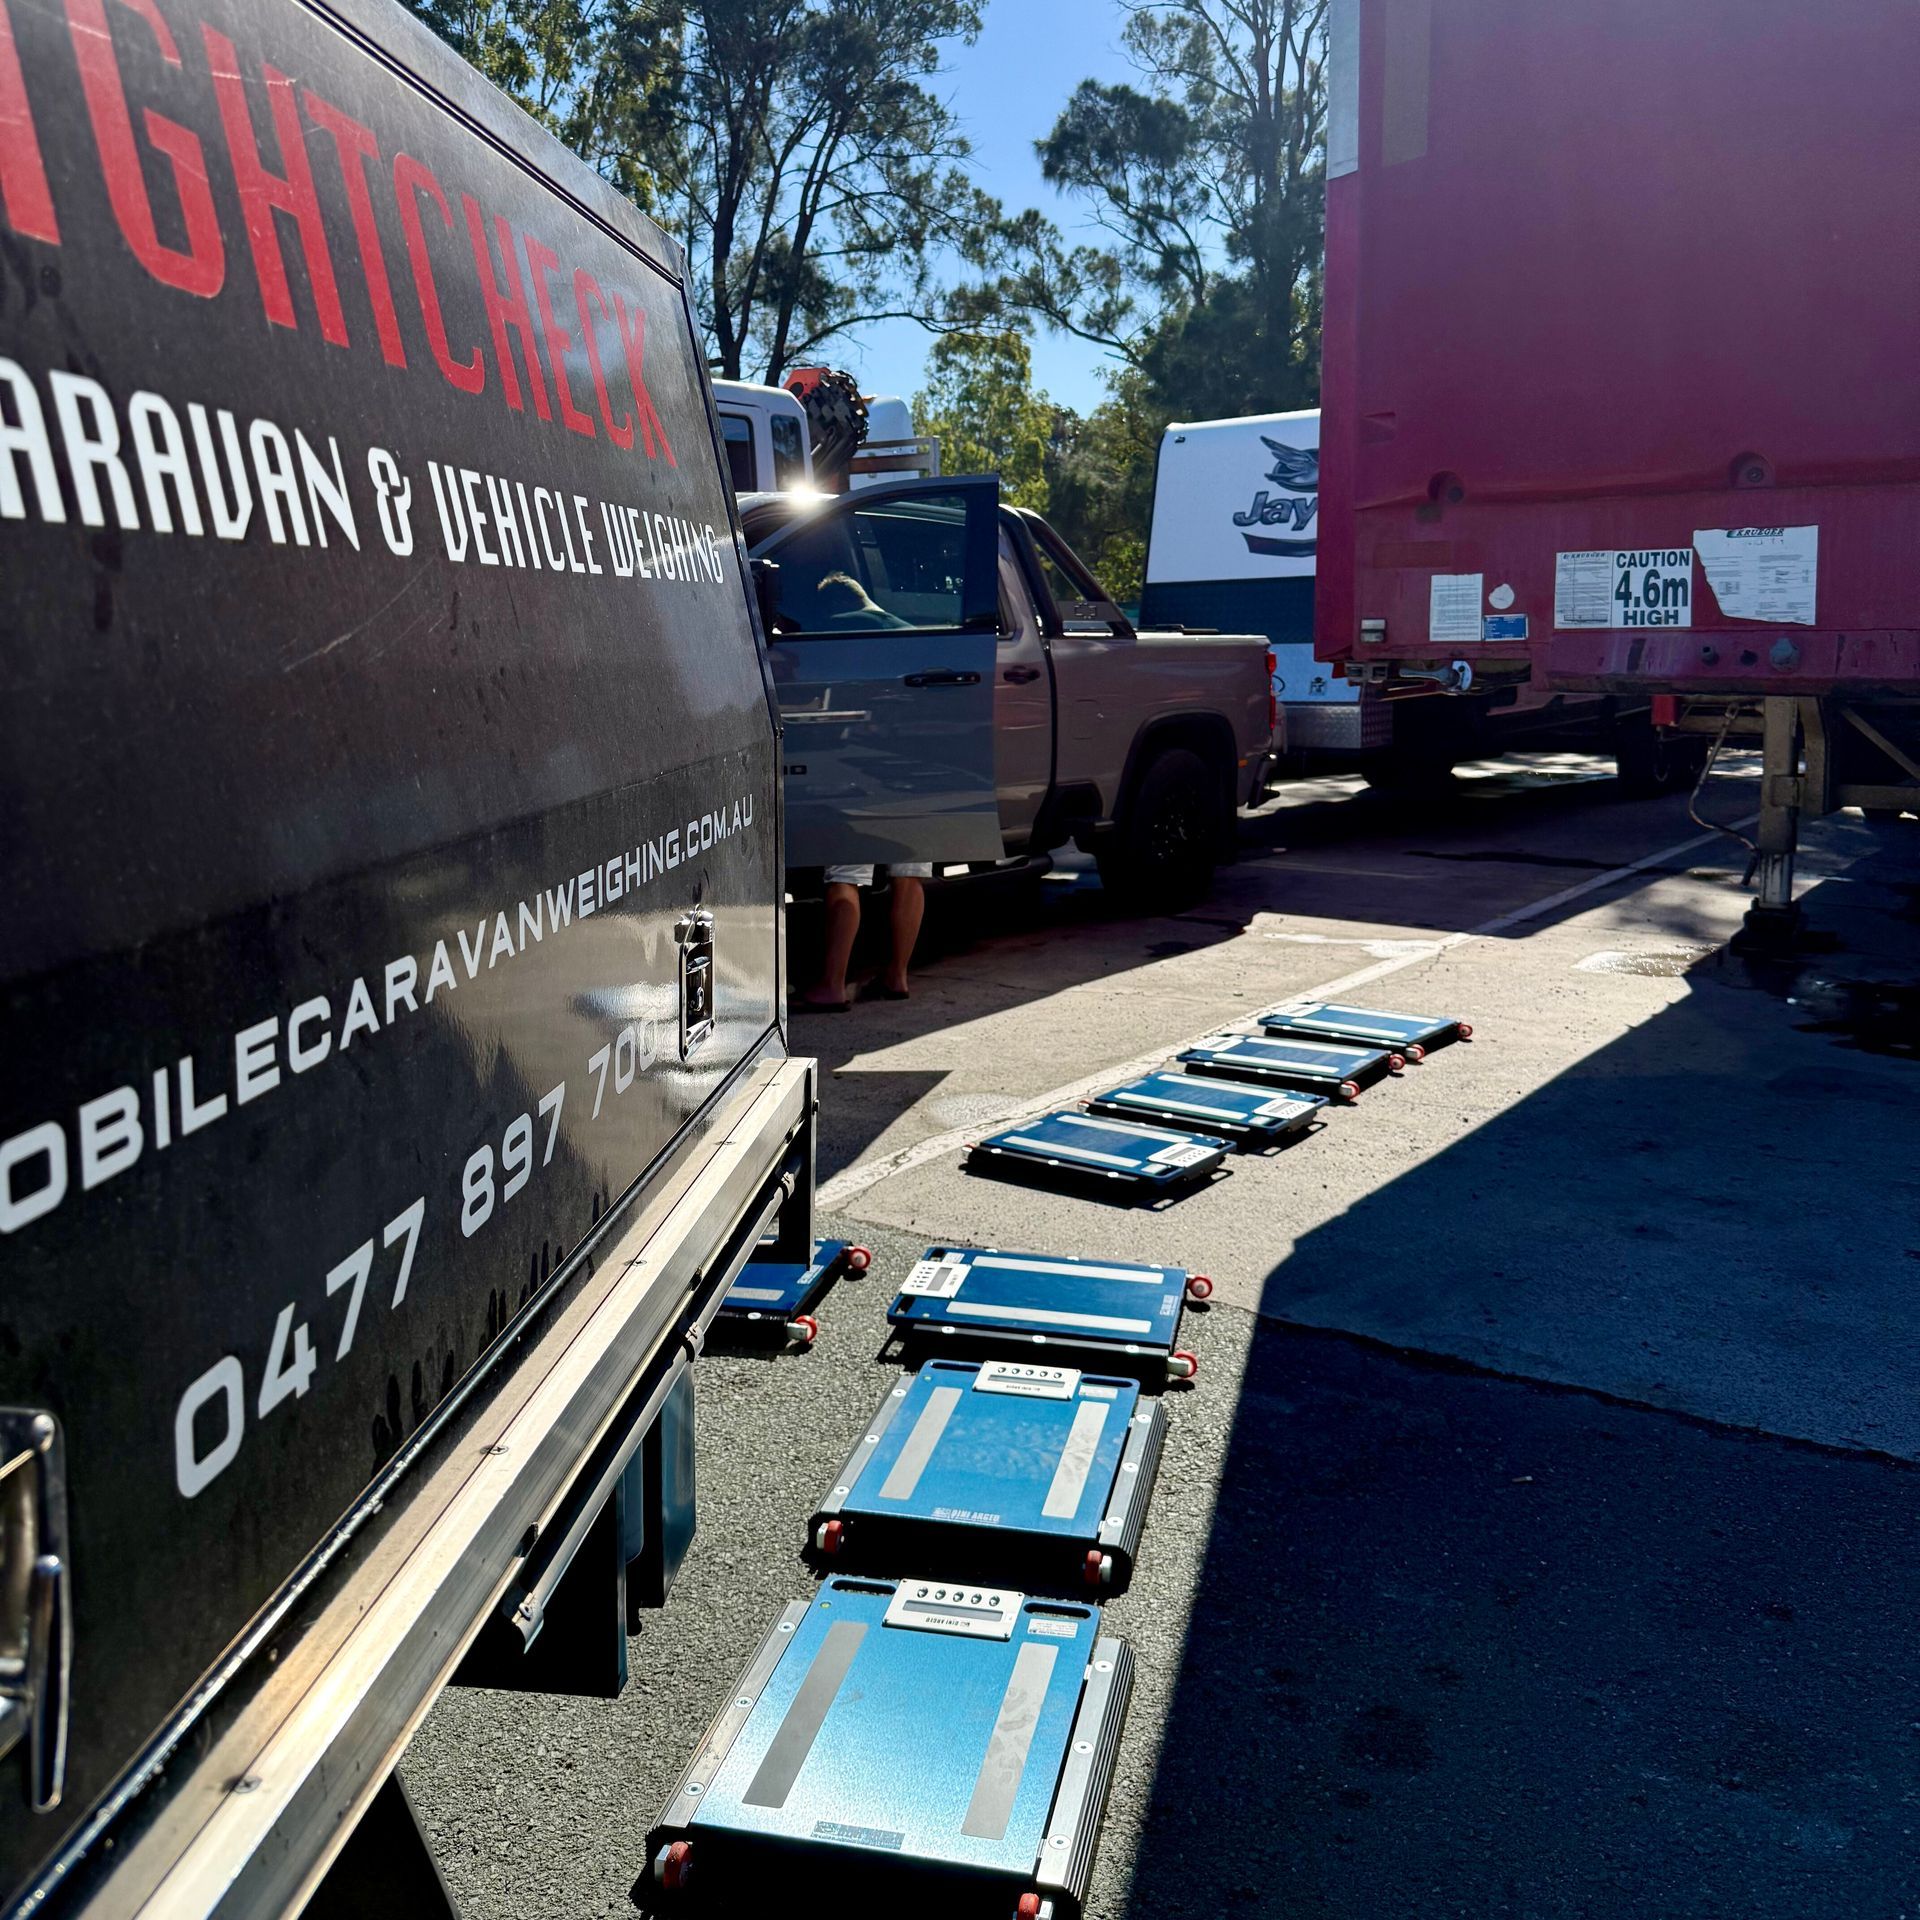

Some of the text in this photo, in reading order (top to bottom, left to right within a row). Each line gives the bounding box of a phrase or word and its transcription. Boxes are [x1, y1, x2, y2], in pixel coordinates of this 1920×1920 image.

[0, 356, 724, 584] ARAVAN & VEHICLE WEIGHING
[1736, 527, 1785, 537] KRUEGER
[1616, 550, 1690, 568] CAUTION
[1614, 569, 1689, 608] 4.6m
[1623, 609, 1679, 626] HIGH
[0, 794, 753, 1234] OBILECARAVANWEIGHING.COM.AU
[174, 1196, 426, 1499] 0477
[461, 1080, 566, 1238] 897
